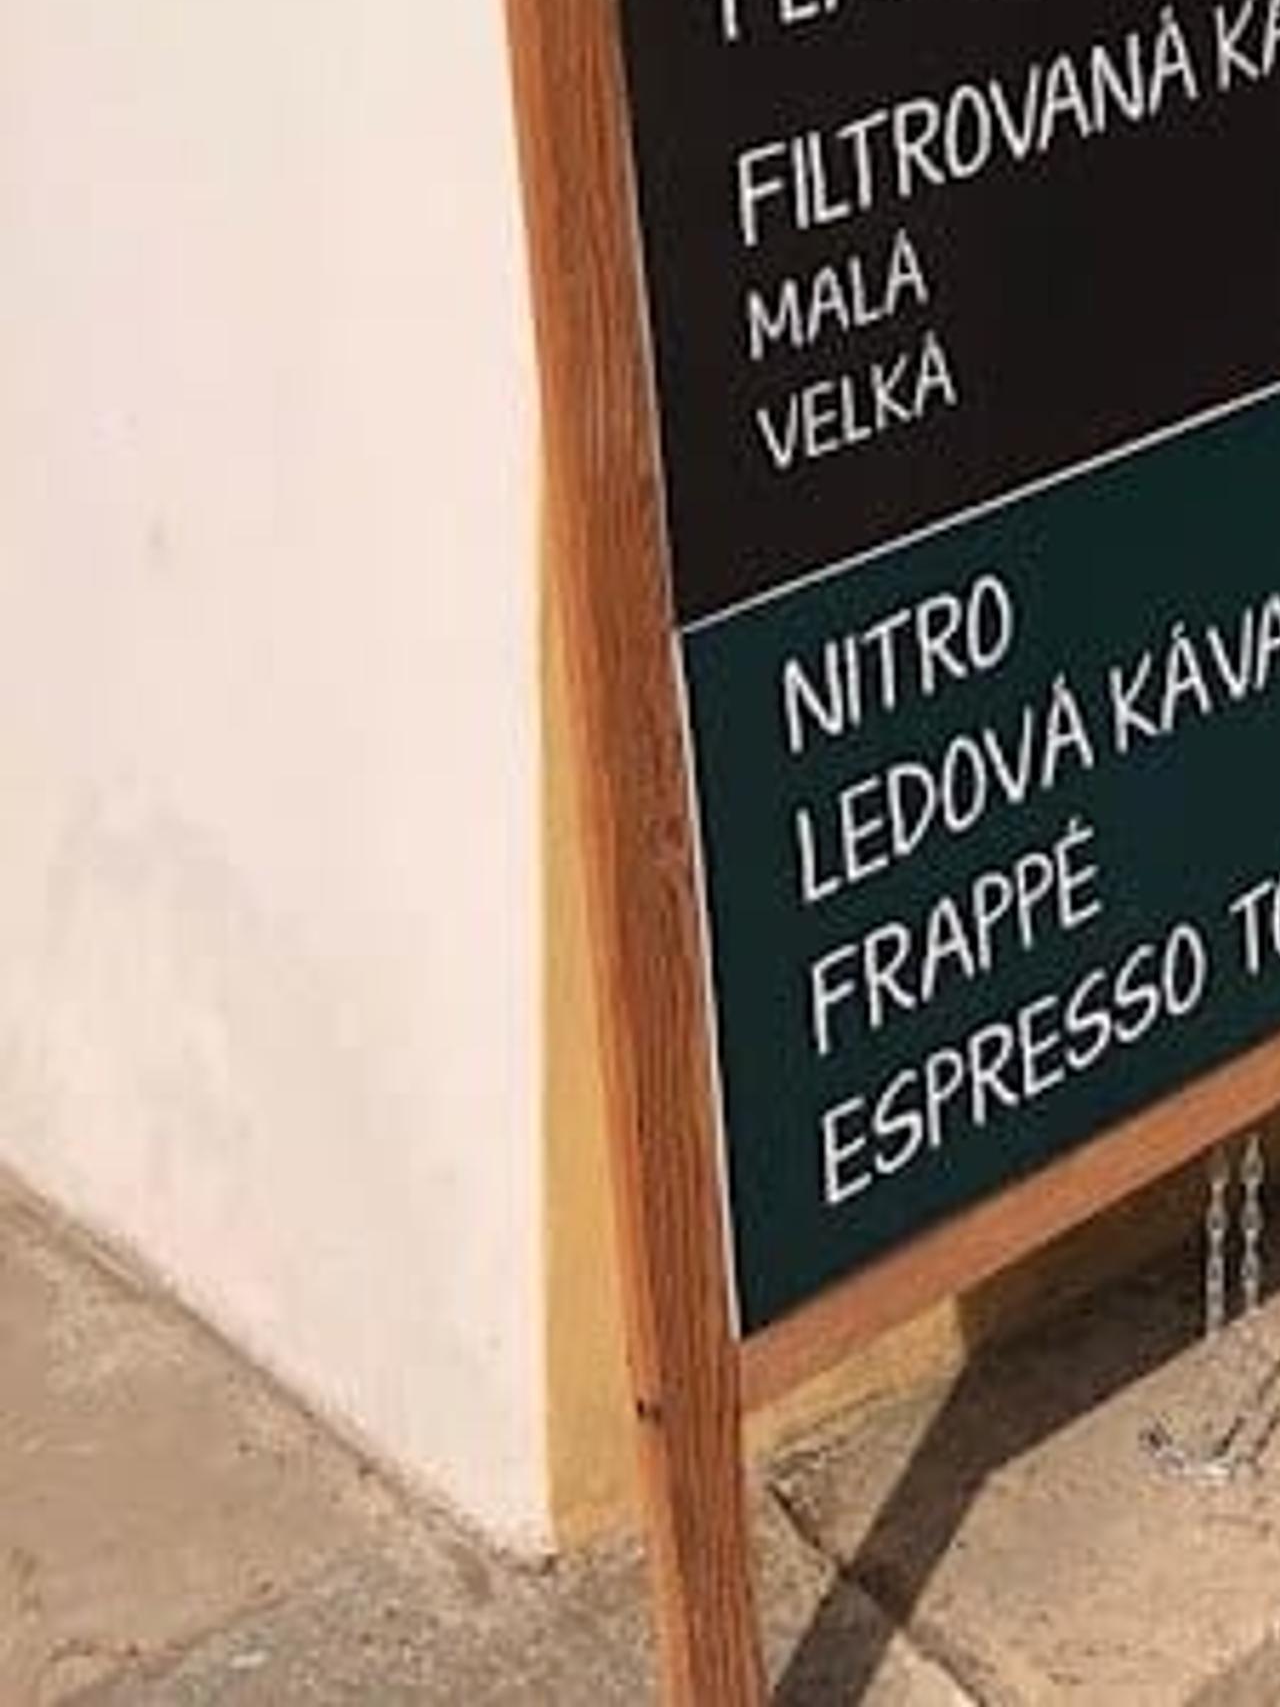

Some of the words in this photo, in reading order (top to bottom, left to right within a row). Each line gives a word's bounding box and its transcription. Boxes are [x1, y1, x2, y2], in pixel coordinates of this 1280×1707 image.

[737, 5, 1200, 247] FILTROVANÁ
[783, 575, 1014, 751] NITRO
[795, 680, 1096, 905] LEDOVÁ
[808, 817, 1102, 1057] FRAPPÉ
[820, 925, 1205, 1205] ESPRESSO
